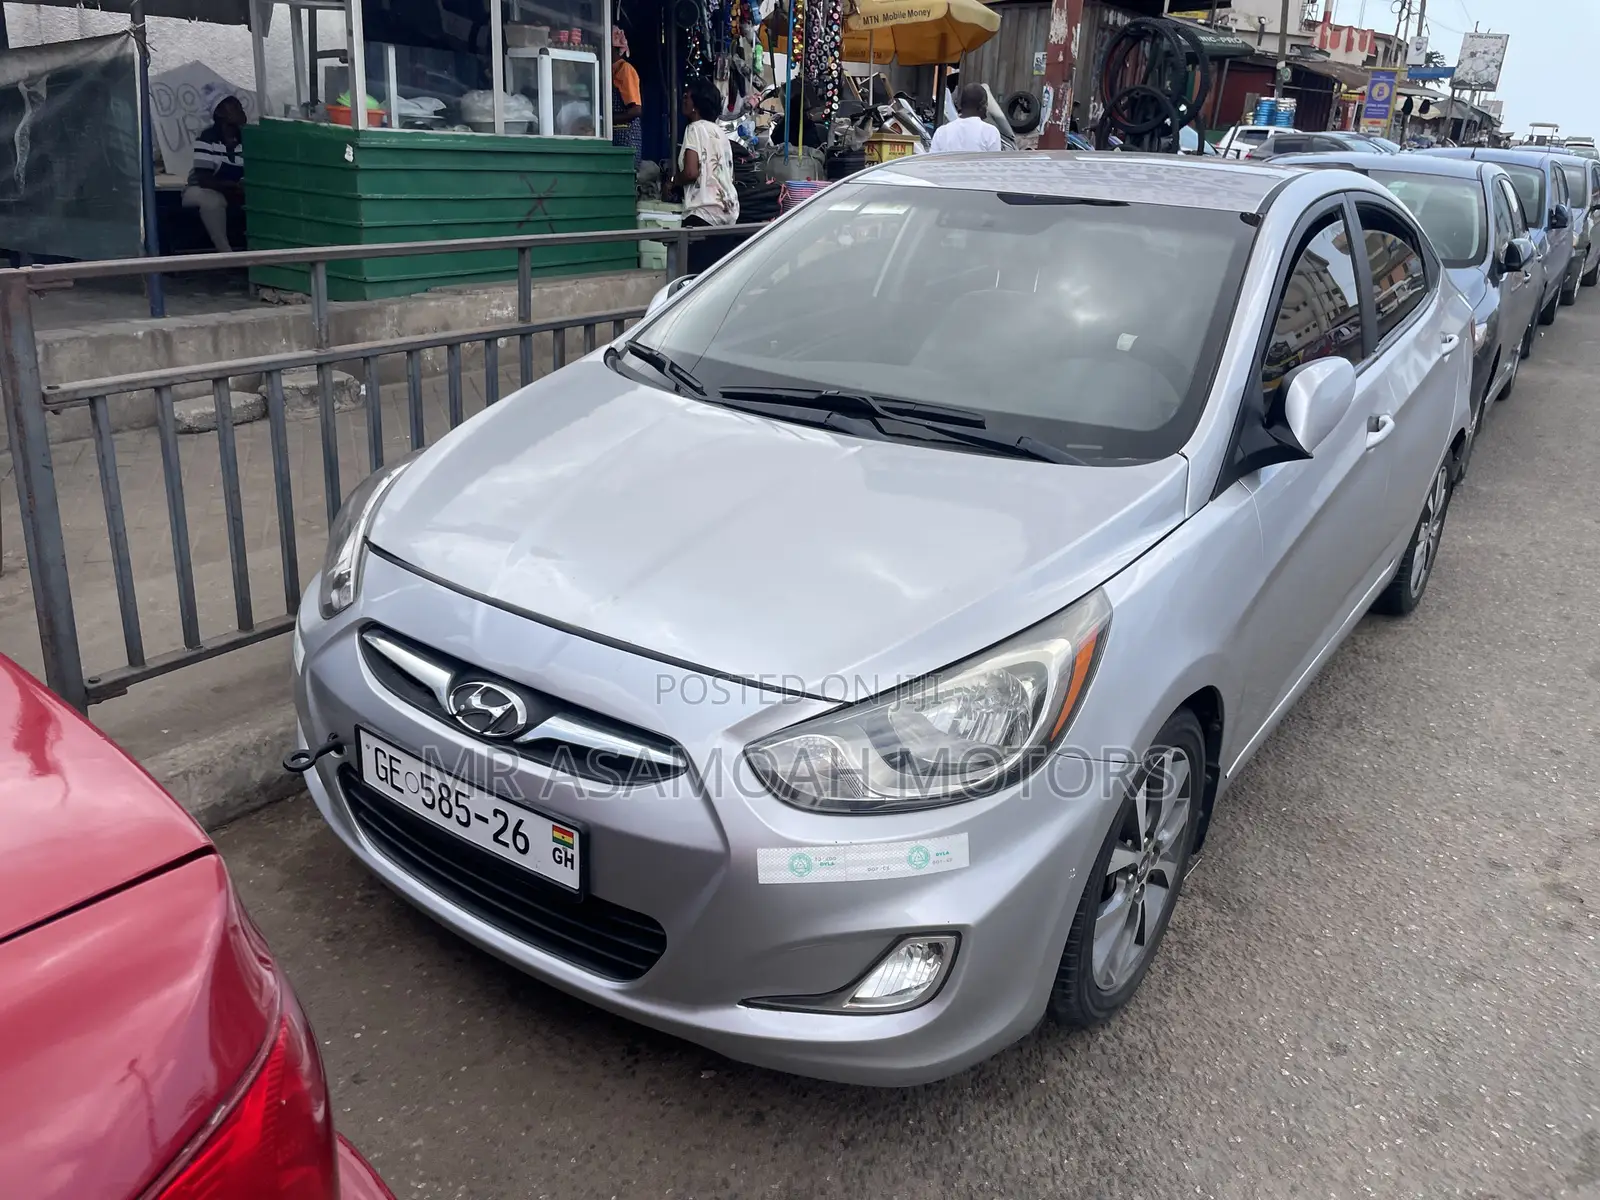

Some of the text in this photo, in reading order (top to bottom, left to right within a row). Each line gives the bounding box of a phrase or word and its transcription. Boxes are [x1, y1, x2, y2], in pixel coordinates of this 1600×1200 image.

[863, 8, 931, 25] MTN Mobile Money
[375, 746, 531, 856] GE 585-26
[552, 846, 575, 871] GH
